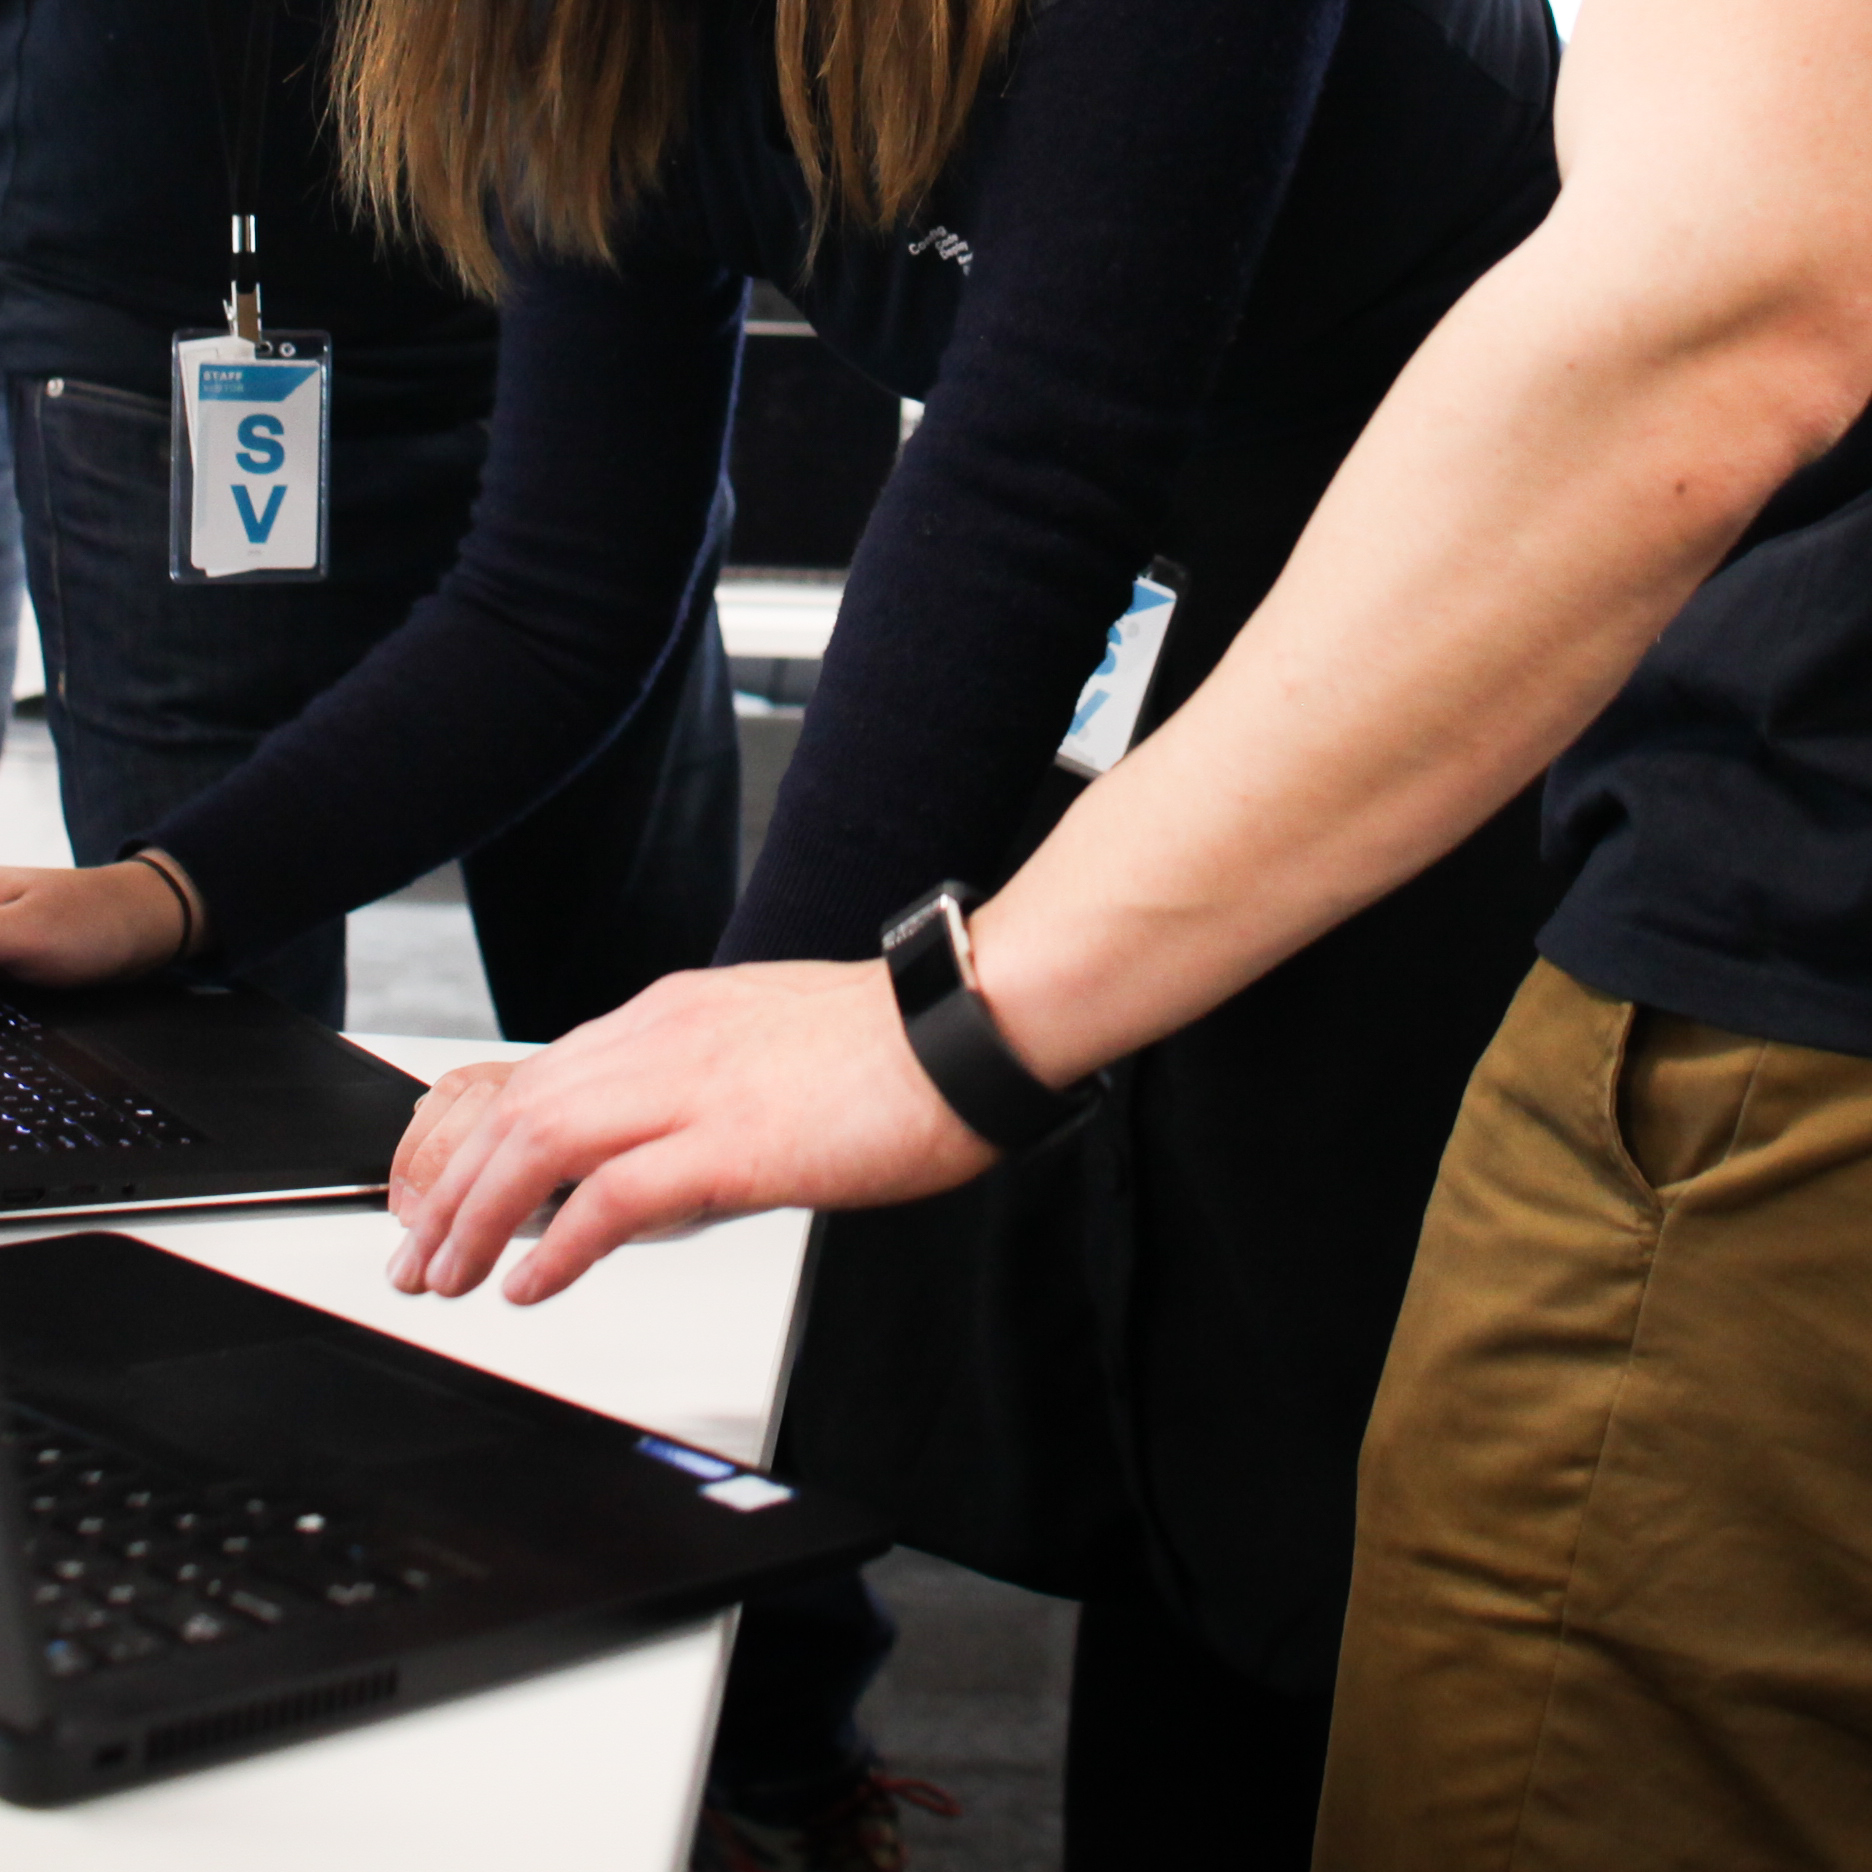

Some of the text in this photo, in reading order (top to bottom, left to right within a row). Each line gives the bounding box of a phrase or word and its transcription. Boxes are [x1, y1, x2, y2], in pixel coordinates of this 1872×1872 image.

[908, 225, 947, 256] Config
[203, 371, 243, 382] STAFF
[235, 413, 285, 475] S
[230, 484, 288, 545] V
